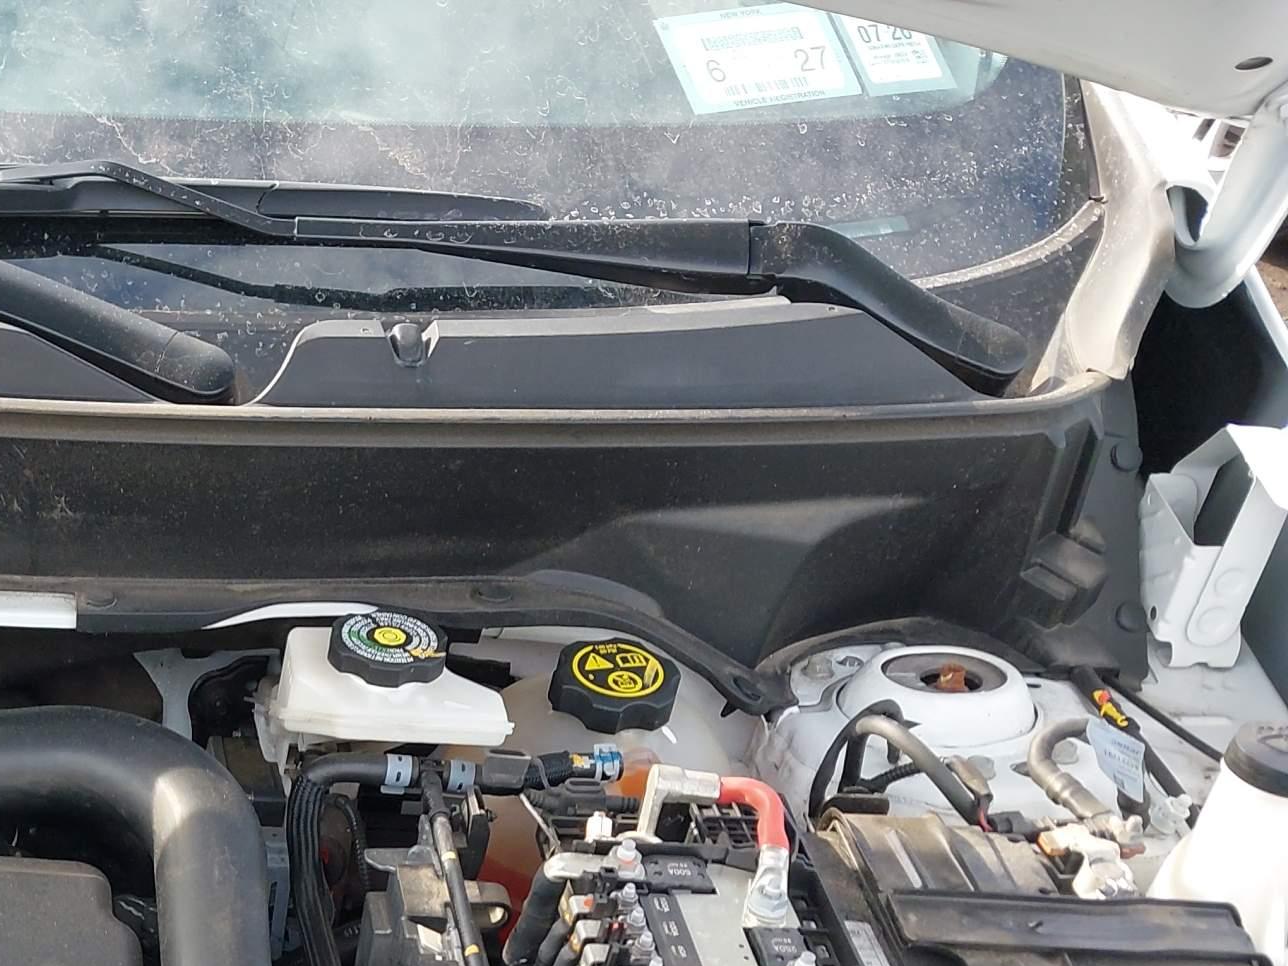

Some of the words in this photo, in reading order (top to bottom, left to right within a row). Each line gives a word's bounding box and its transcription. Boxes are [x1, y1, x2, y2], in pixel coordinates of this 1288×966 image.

[857, 24, 881, 43] 07
[706, 59, 727, 83] 6
[794, 45, 827, 73] 27
